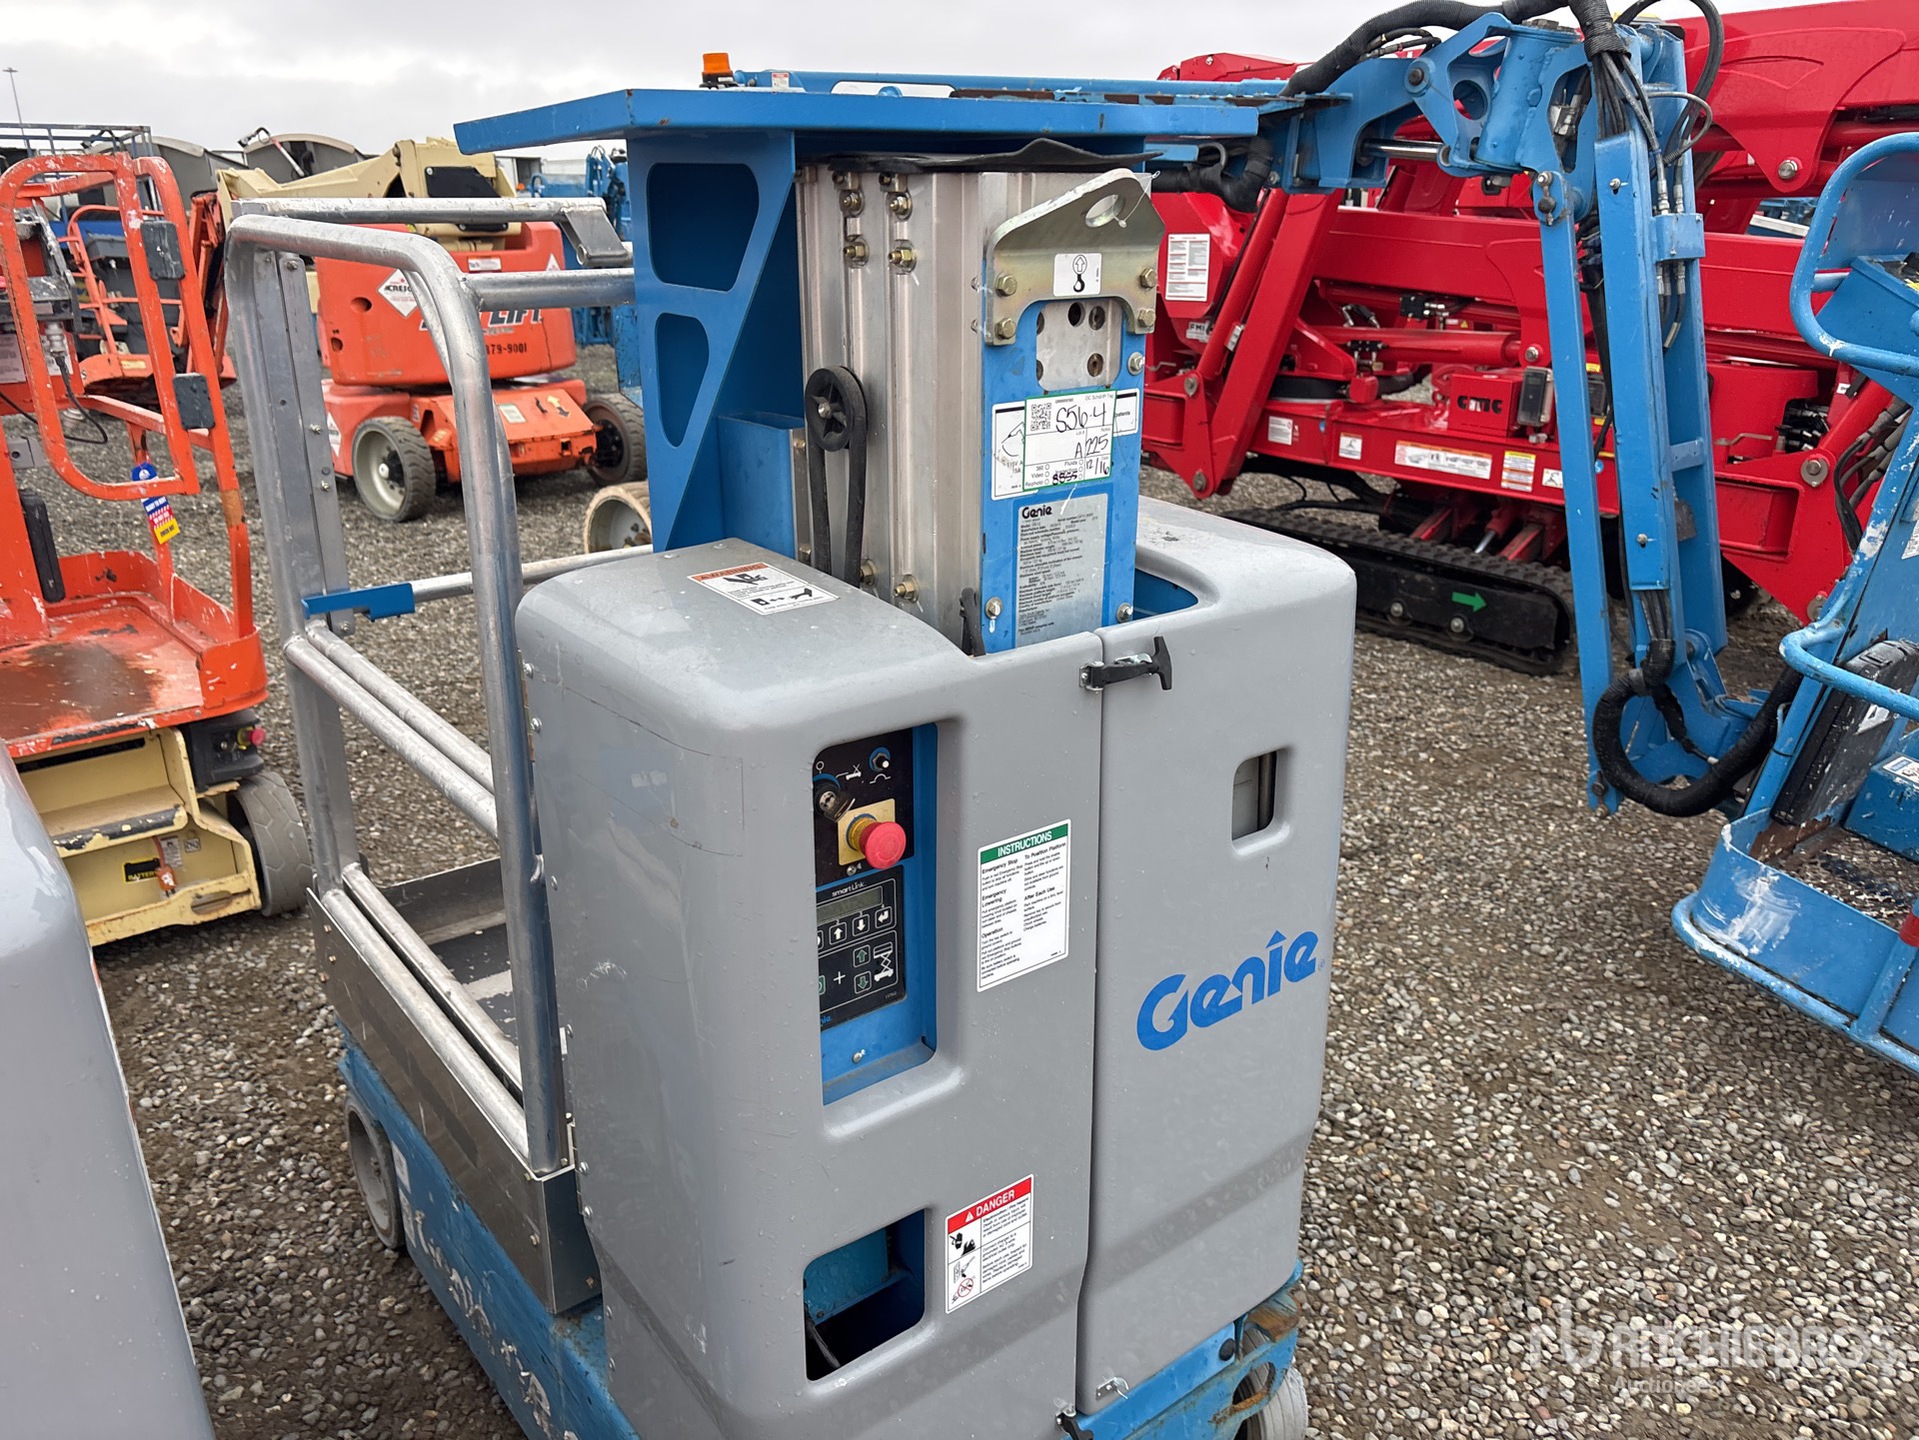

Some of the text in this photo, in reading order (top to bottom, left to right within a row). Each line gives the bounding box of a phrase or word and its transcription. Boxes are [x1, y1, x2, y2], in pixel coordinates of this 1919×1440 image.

[1022, 505, 1052, 519] Genie
[997, 830, 1052, 857] INSTRUCTIONS
[1031, 848, 1048, 858] Position
[1049, 842, 1066, 852] Platform
[982, 858, 1018, 874] Emergency Stop
[982, 889, 1007, 901] Emergency
[982, 897, 1002, 908] Lowering
[982, 927, 1003, 938] Operation
[1136, 930, 1319, 1051] Genie
[976, 1189, 1015, 1217] DANGER
